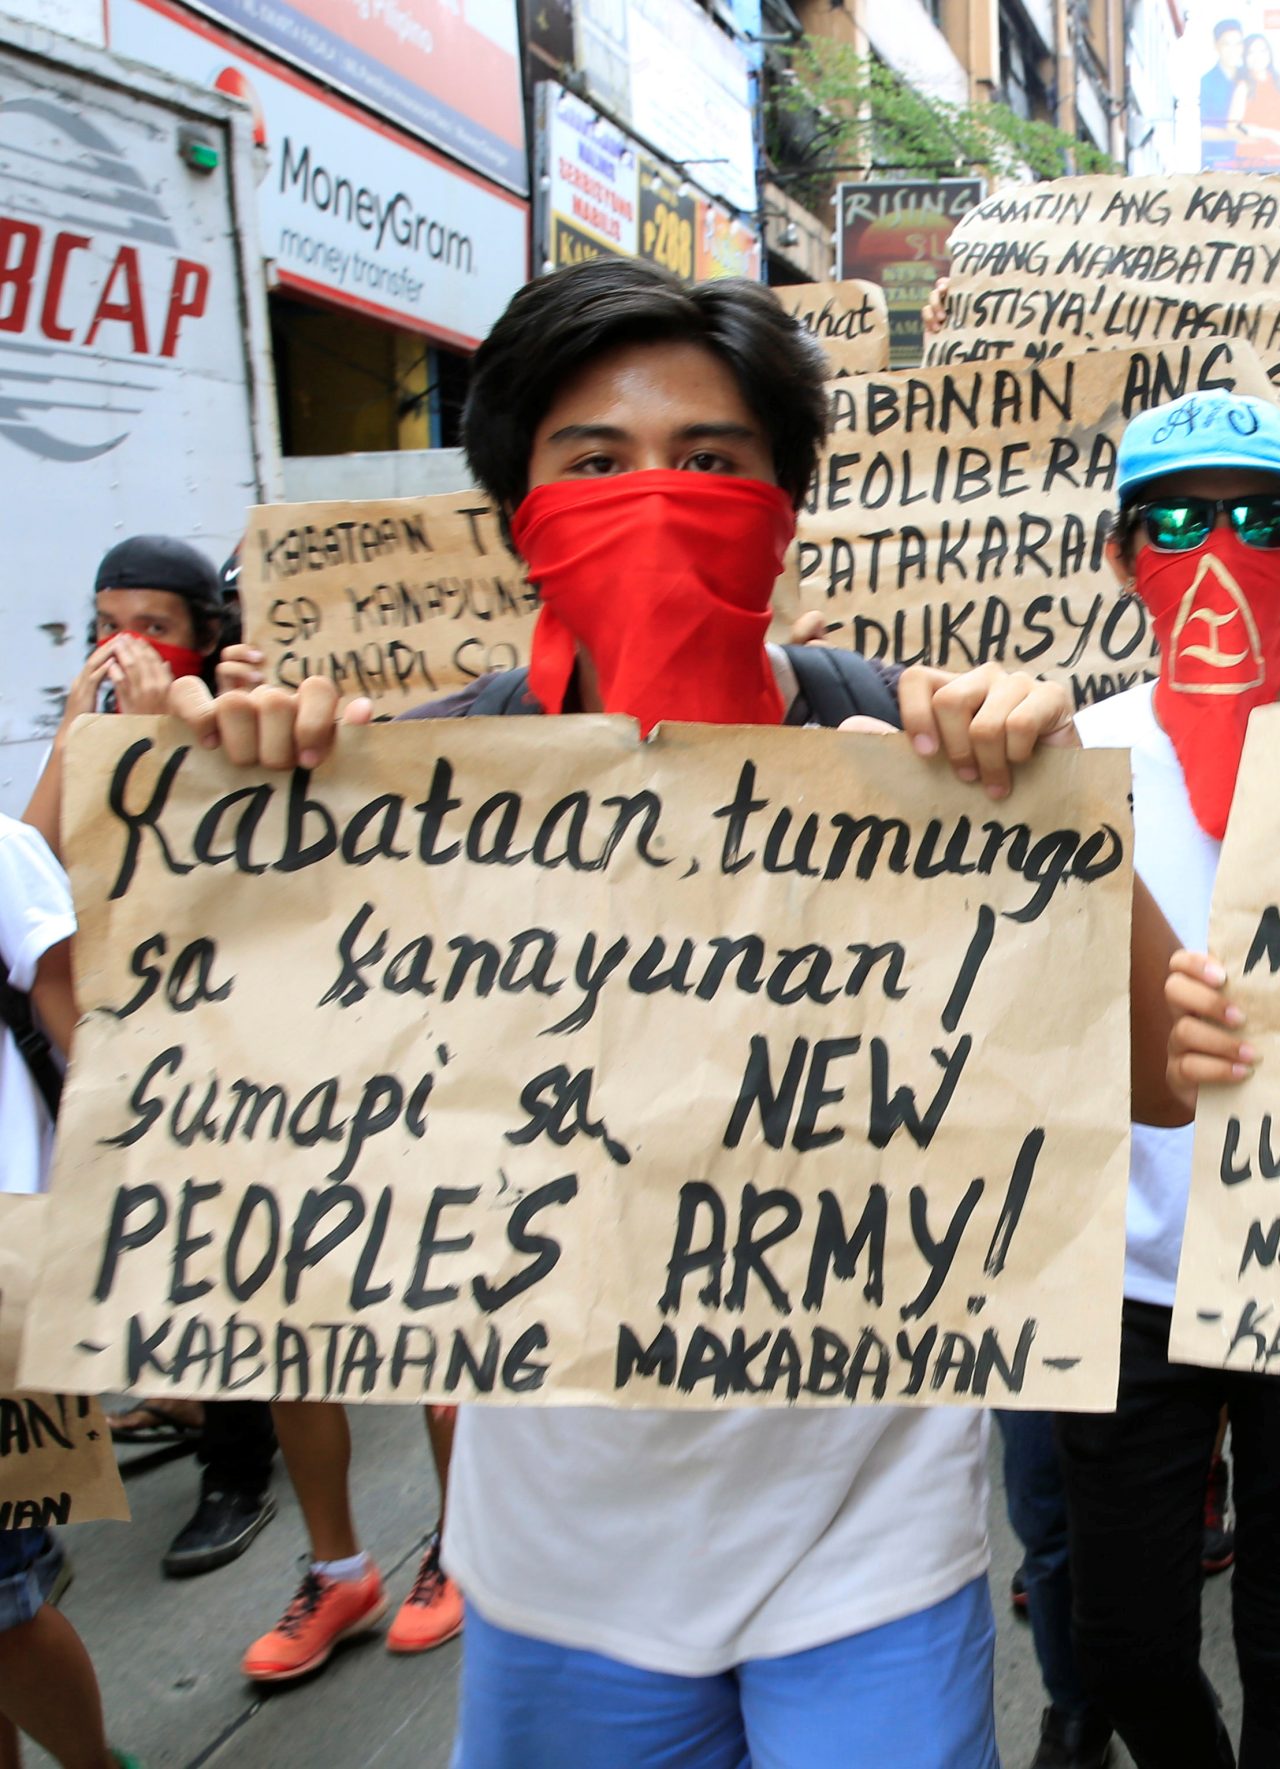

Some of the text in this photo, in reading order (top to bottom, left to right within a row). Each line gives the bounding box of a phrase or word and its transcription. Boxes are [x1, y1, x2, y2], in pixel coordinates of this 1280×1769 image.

[281, 137, 476, 275] MoneyGram
[845, 188, 974, 227] RISING
[1101, 187, 1172, 227] ANG
[279, 225, 426, 304] money transfer
[795, 292, 875, 341] ahat
[1104, 294, 1259, 343] LUTASIN
[826, 360, 1076, 437] ABANAN
[267, 575, 541, 646] SA KANAYUNA
[108, 736, 1124, 924] Kabataan, tumungo
[96, 931, 236, 1020] sa
[97, 1042, 457, 1182] Sumapi
[722, 1033, 974, 1151] NEW
[656, 1127, 1046, 1320] ARMY!
